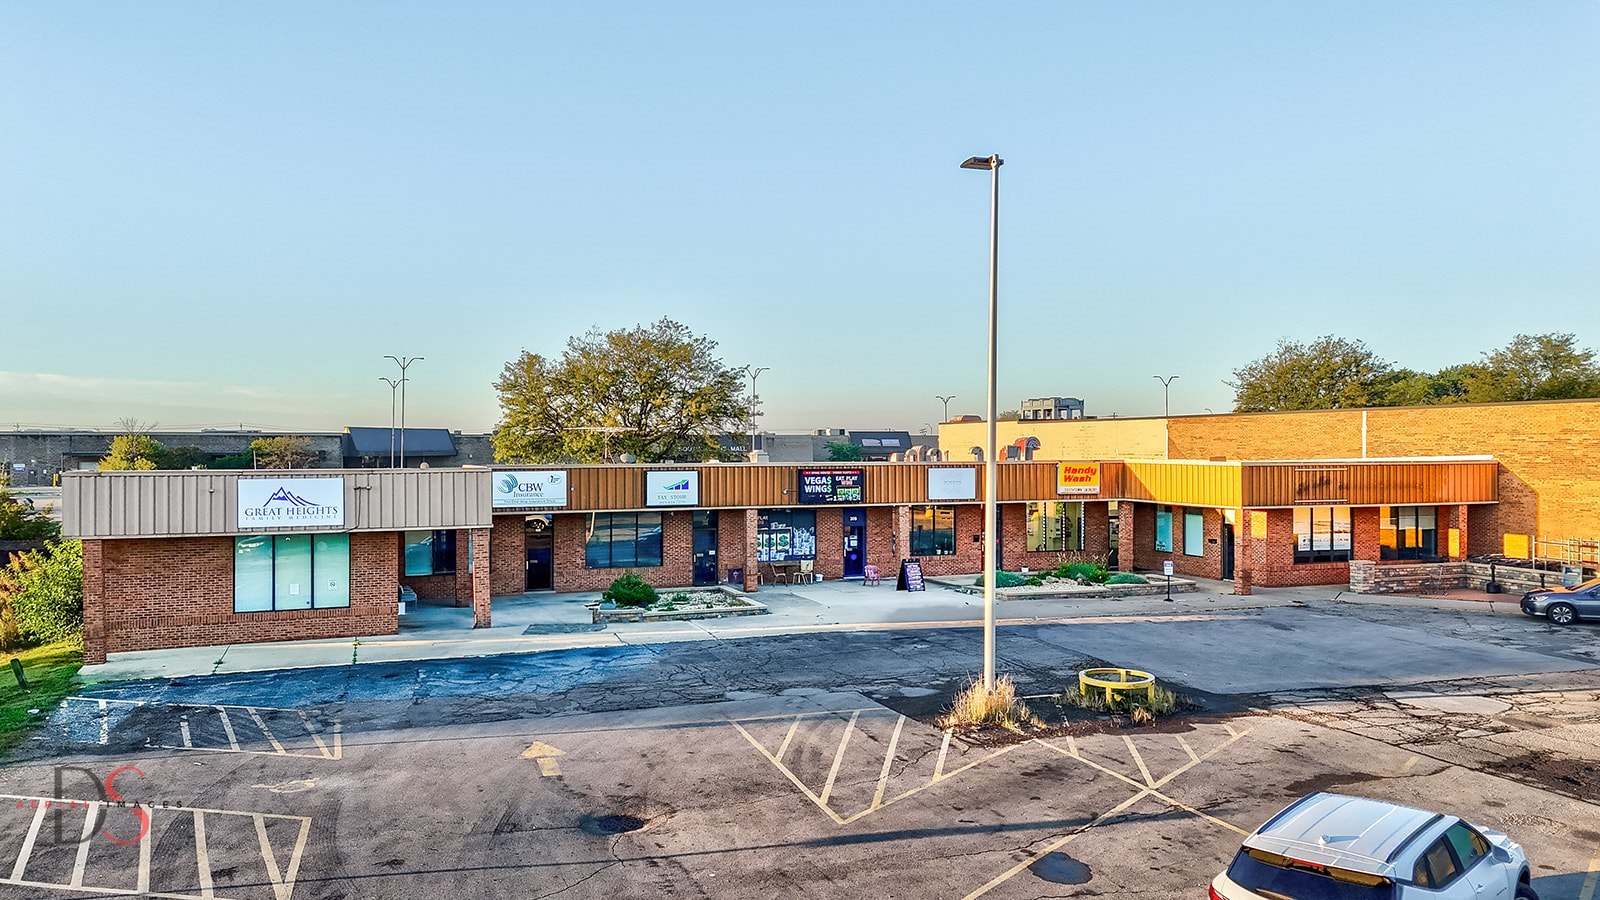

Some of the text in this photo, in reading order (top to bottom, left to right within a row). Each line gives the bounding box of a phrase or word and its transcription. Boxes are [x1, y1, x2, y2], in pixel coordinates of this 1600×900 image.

[1064, 466, 1097, 476] Handy
[518, 483, 543, 492] CBW
[245, 506, 338, 517] GREAT HEIGHTS
